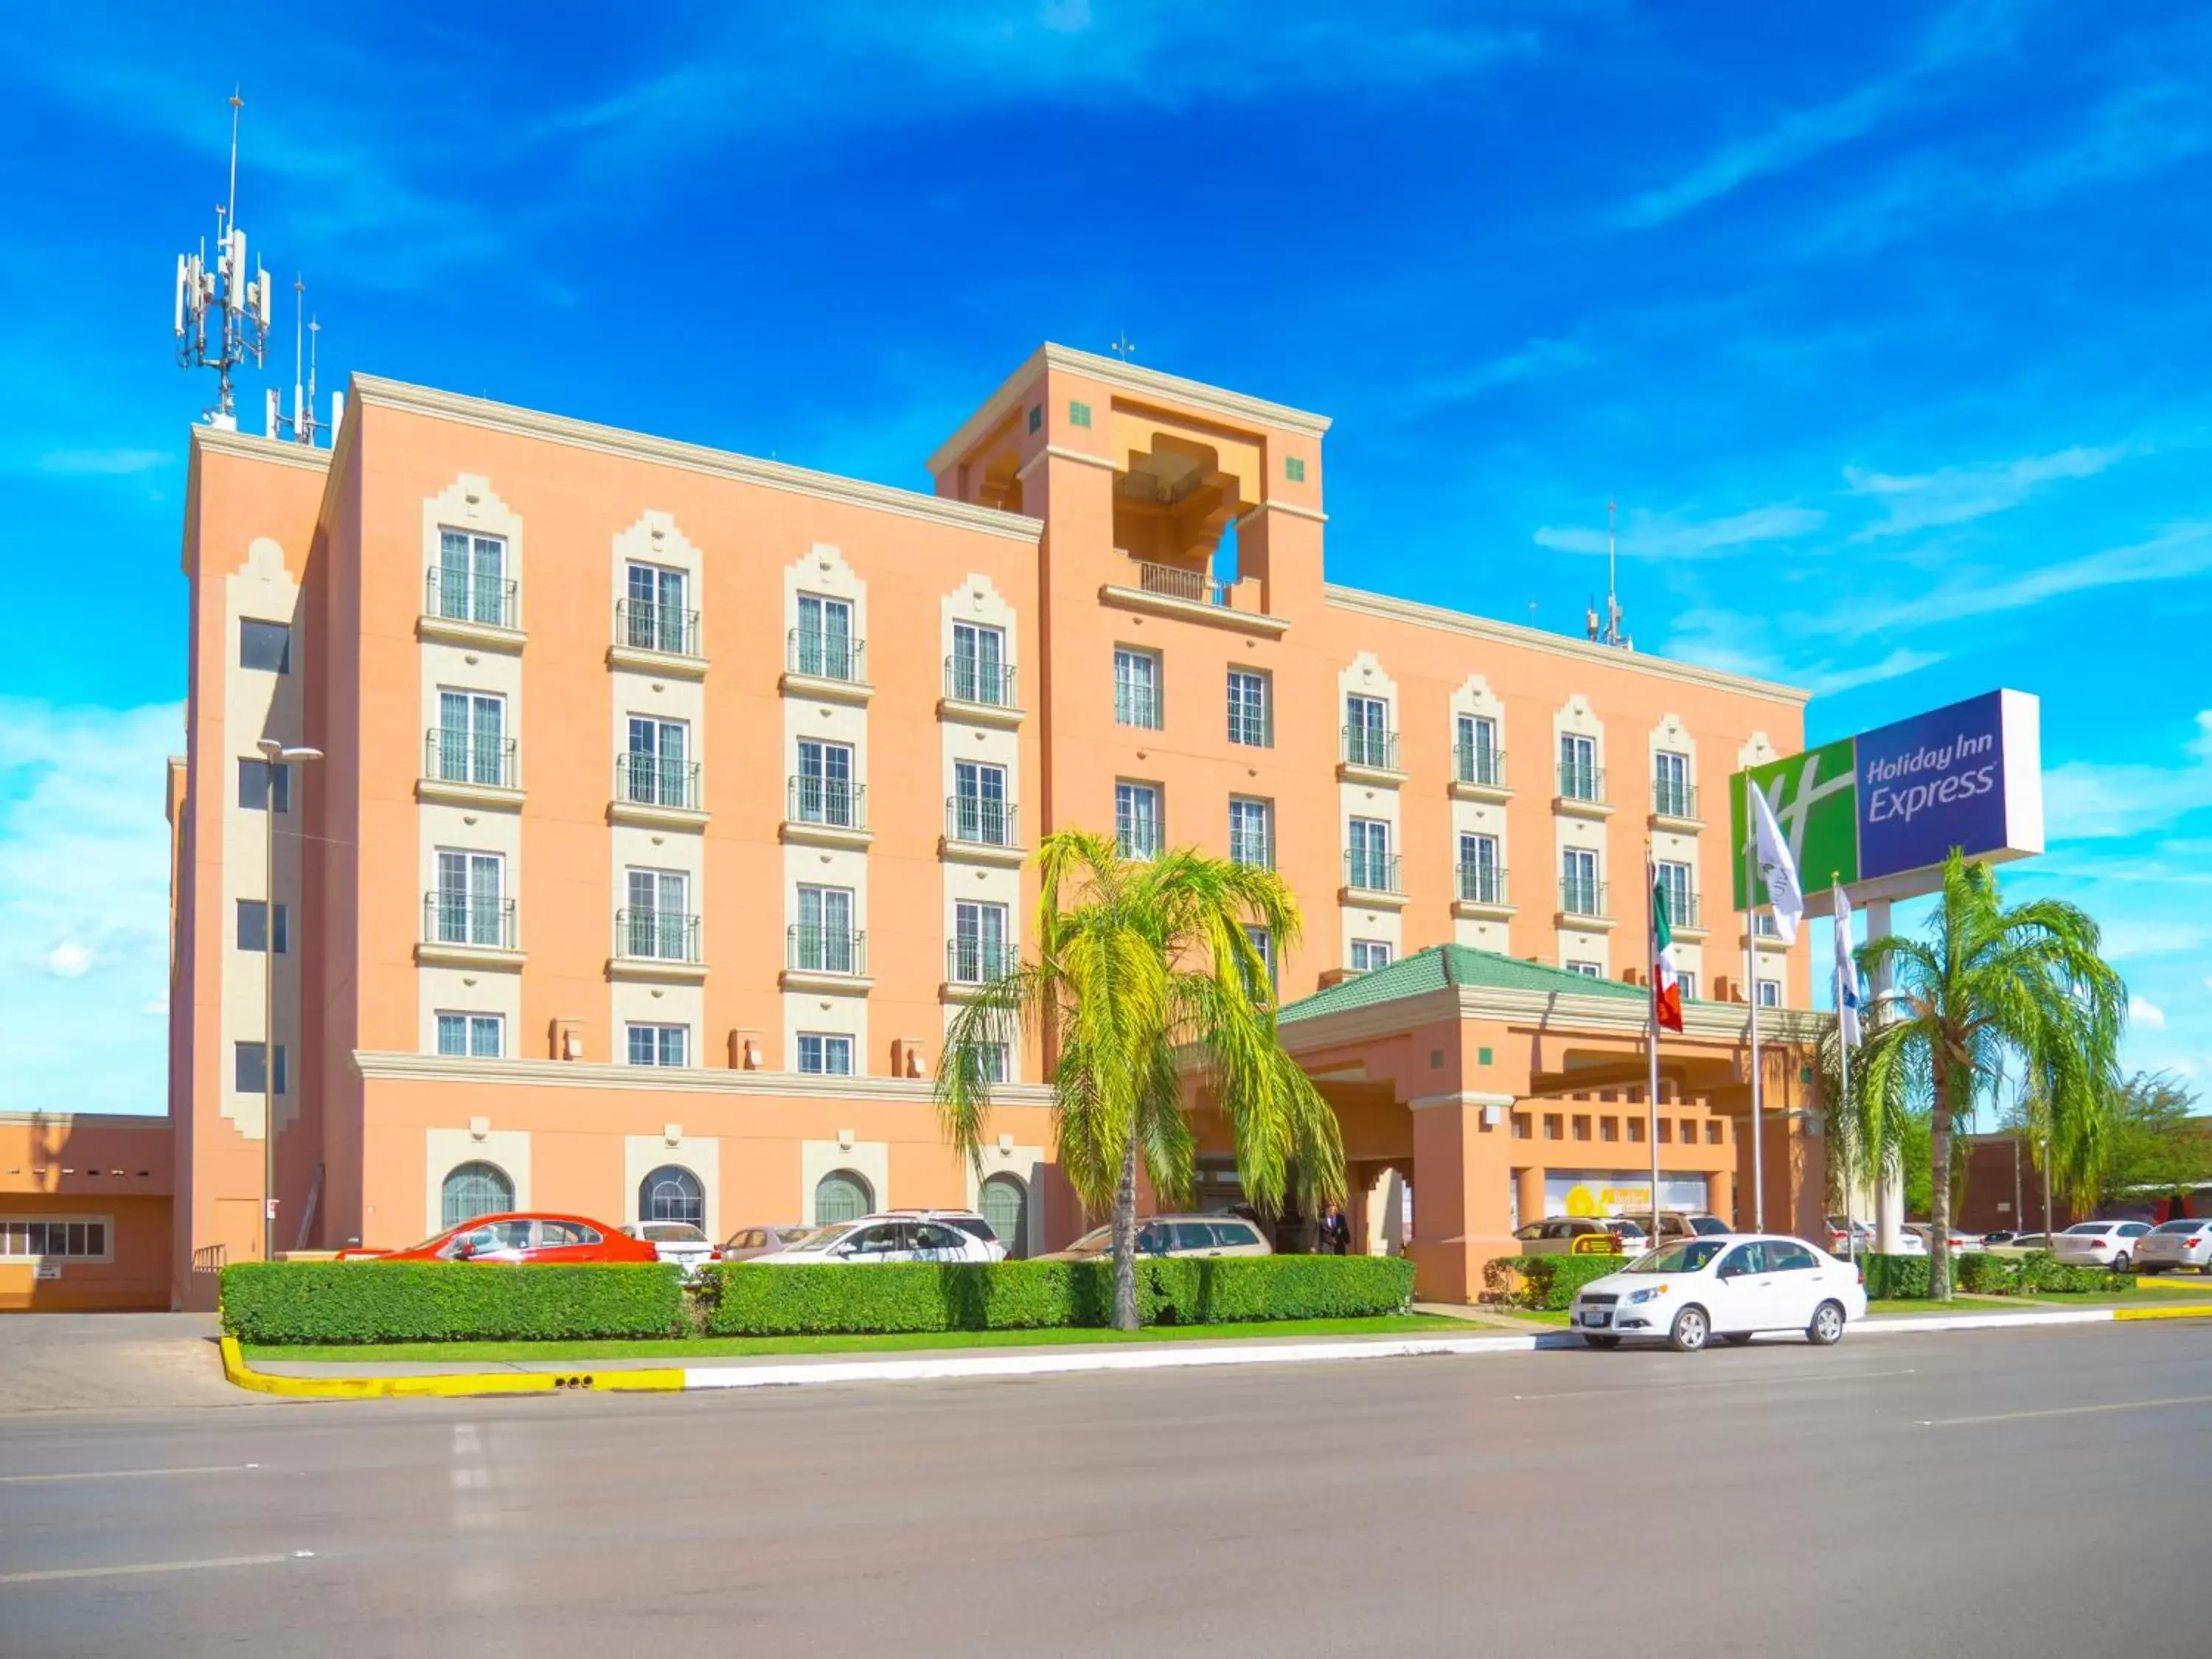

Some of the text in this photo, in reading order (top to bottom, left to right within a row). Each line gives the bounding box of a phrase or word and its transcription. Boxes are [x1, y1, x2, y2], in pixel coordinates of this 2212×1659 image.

[1867, 734, 1992, 785] Holiday Inn
[1869, 765, 1993, 822] Express
